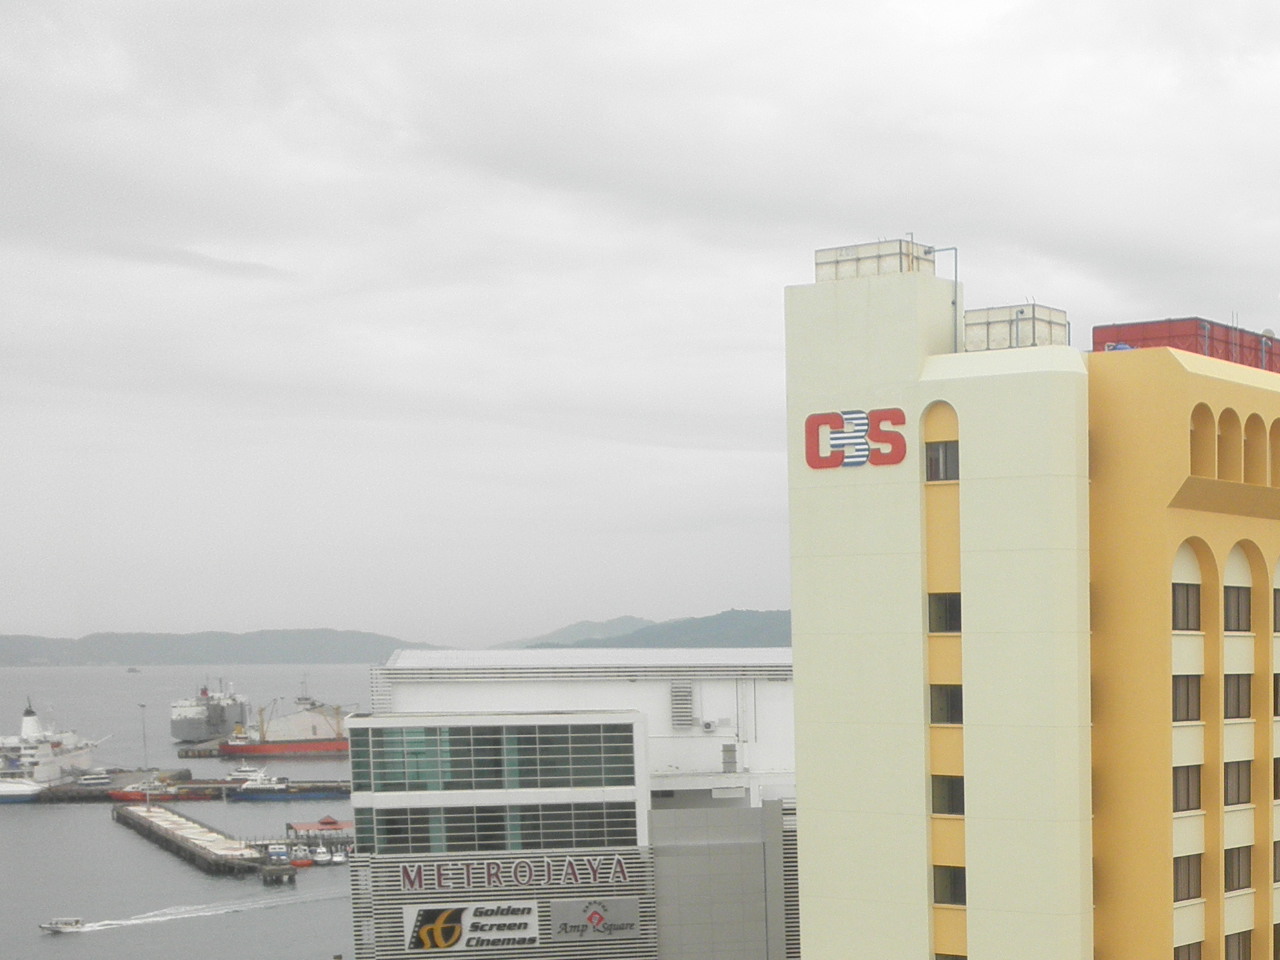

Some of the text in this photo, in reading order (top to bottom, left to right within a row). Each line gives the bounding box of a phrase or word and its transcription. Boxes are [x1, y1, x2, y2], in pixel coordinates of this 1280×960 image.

[805, 408, 907, 470] CBS
[400, 854, 629, 891] METROJAYA
[473, 906, 532, 917] Golden
[469, 922, 528, 932] Screen
[557, 922, 636, 937] Amp Square
[465, 936, 537, 947] Cinemas
